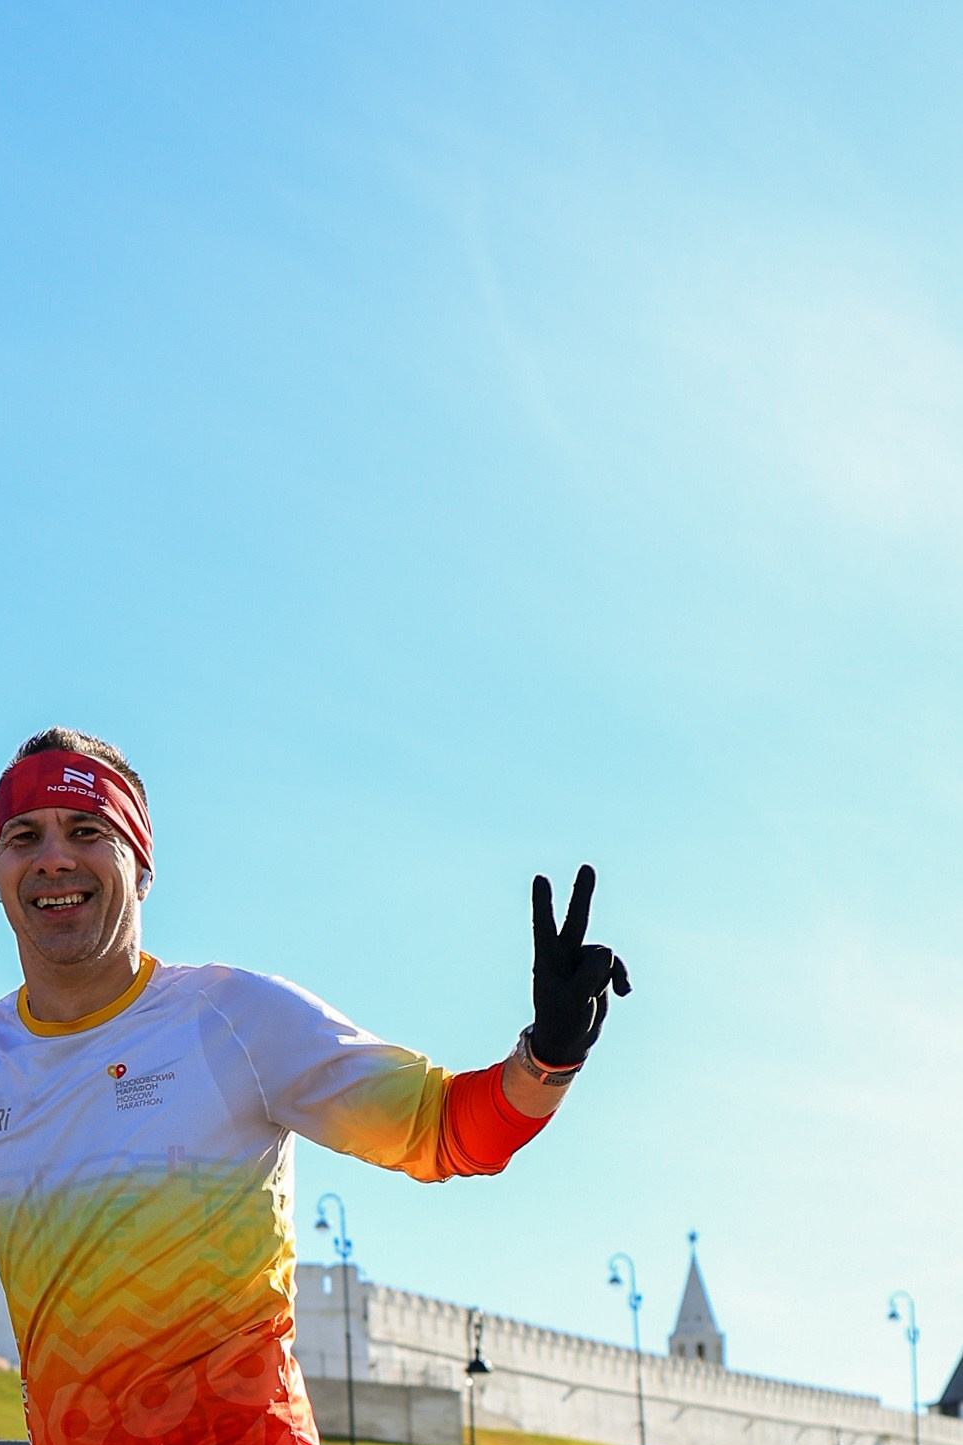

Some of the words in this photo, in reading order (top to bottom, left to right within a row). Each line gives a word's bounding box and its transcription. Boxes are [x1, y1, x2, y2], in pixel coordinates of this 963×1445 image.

[47, 785, 108, 804] NORDSKI
[115, 1072, 175, 1089] МОСКОВСКИЙ
[116, 1083, 158, 1096] МАРАФОН
[116, 1091, 154, 1104] MOSCOW
[117, 1097, 164, 1111] MARATHON
